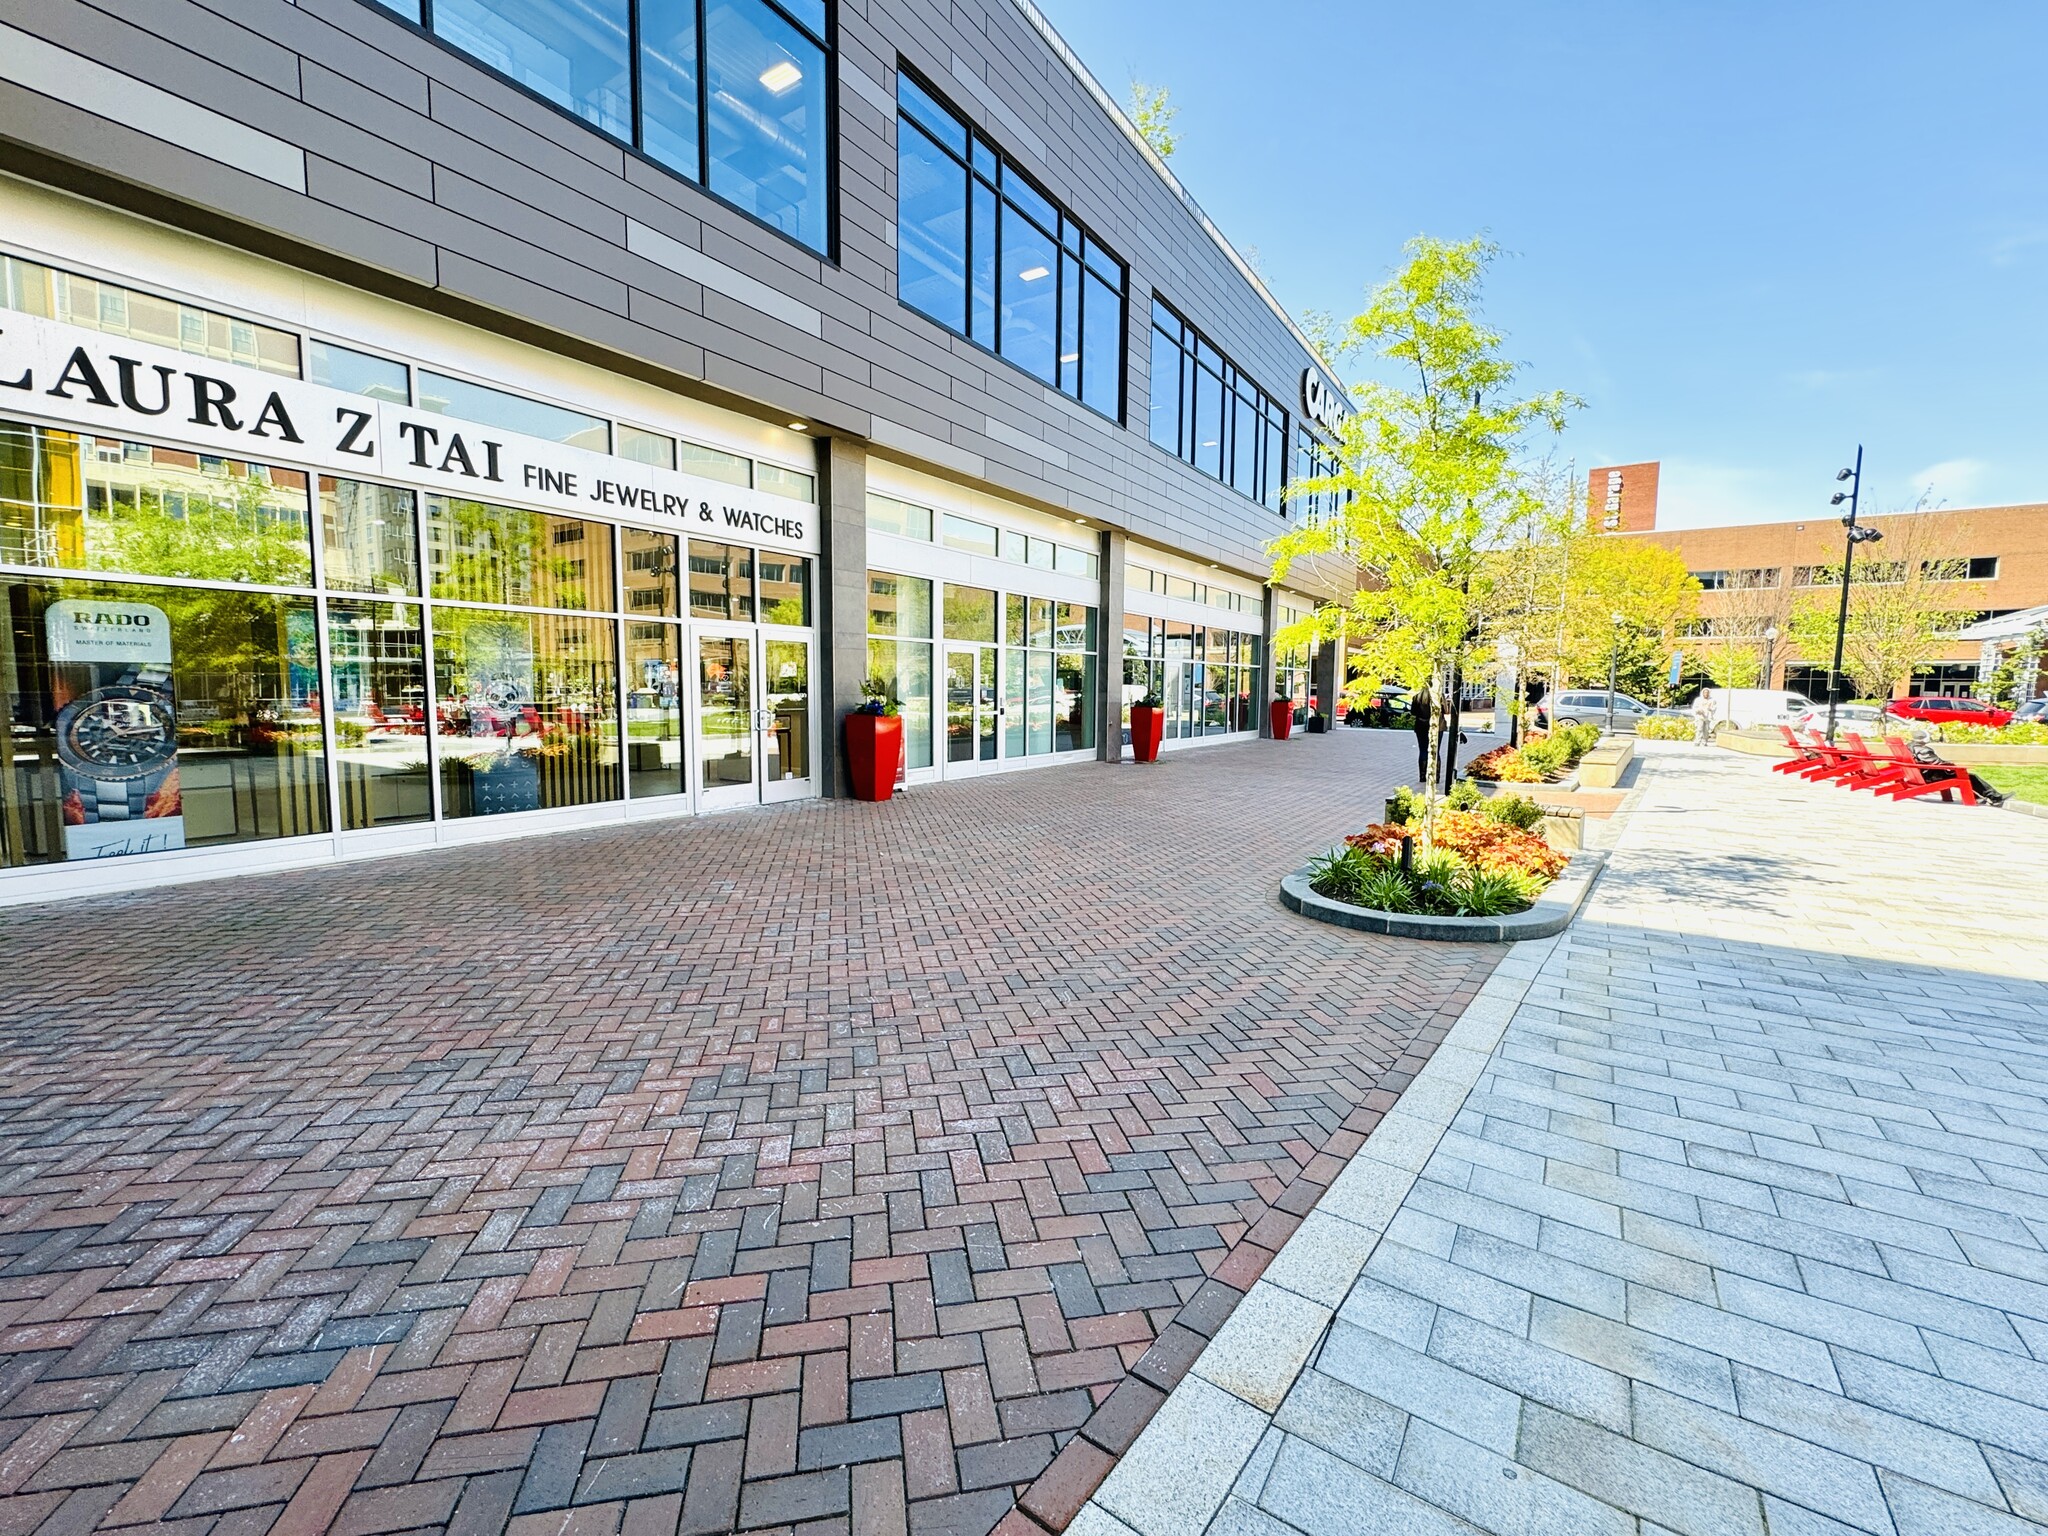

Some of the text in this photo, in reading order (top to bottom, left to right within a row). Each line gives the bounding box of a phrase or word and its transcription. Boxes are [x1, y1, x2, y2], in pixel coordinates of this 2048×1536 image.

[336, 407, 374, 457] Z
[400, 421, 504, 483] TAI
[524, 464, 577, 497] FINE
[590, 479, 689, 518] JEWELRY
[699, 502, 714, 523] &
[723, 506, 803, 540] WATCHES
[73, 612, 150, 626] RADO
[116, 640, 152, 648] MATERIALS
